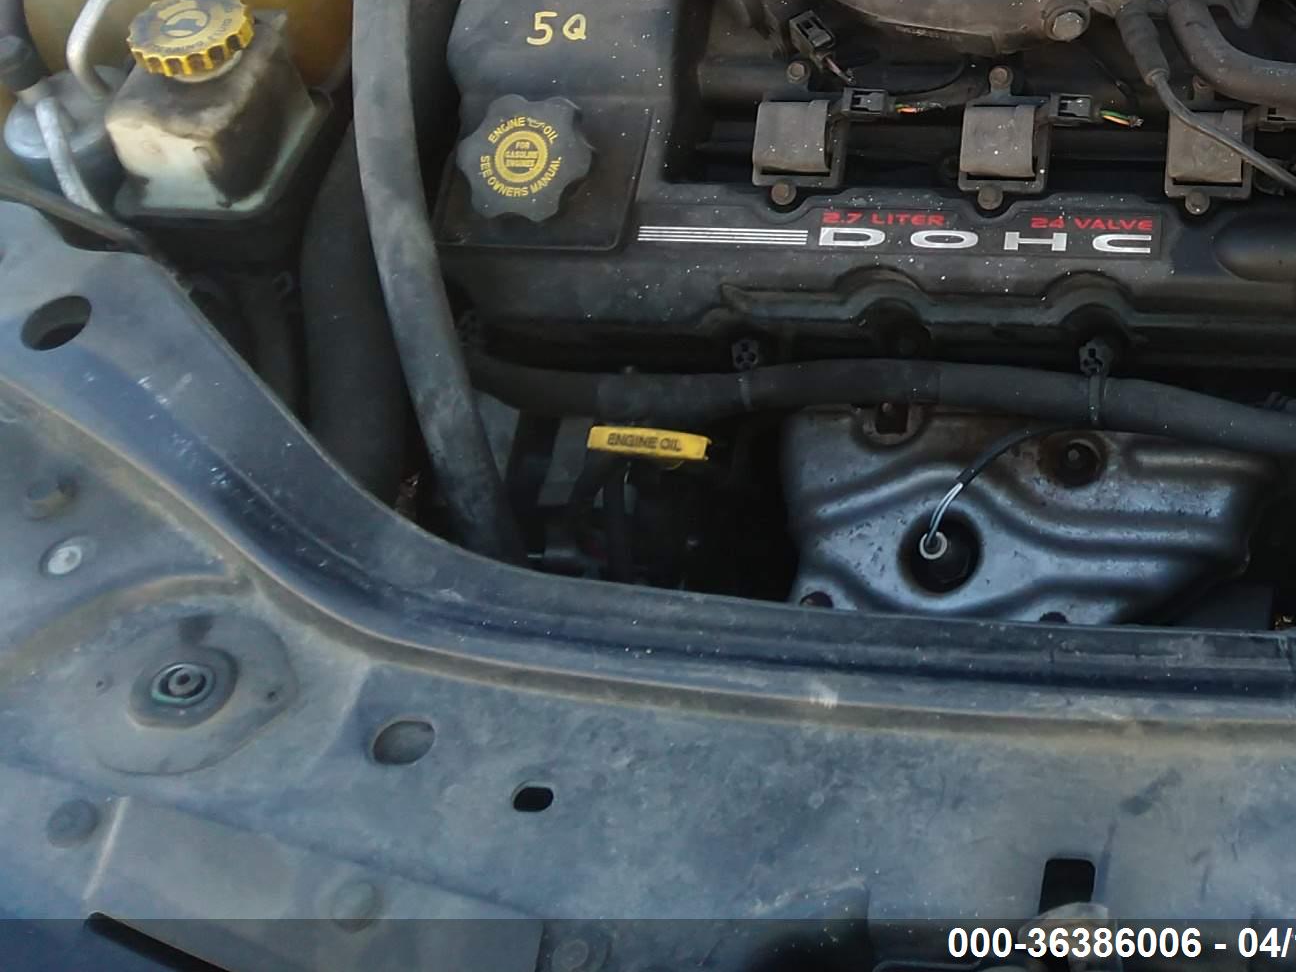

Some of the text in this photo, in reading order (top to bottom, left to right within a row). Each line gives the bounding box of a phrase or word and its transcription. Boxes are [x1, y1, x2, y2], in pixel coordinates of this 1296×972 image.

[488, 116, 559, 144] ENGINE OIL
[480, 155, 561, 197] SEE OWNERS MANUAL
[822, 212, 945, 226] 2.7 LITER
[1031, 217, 1153, 230] 24 VALVE
[607, 433, 682, 452] ENGINE OIL
